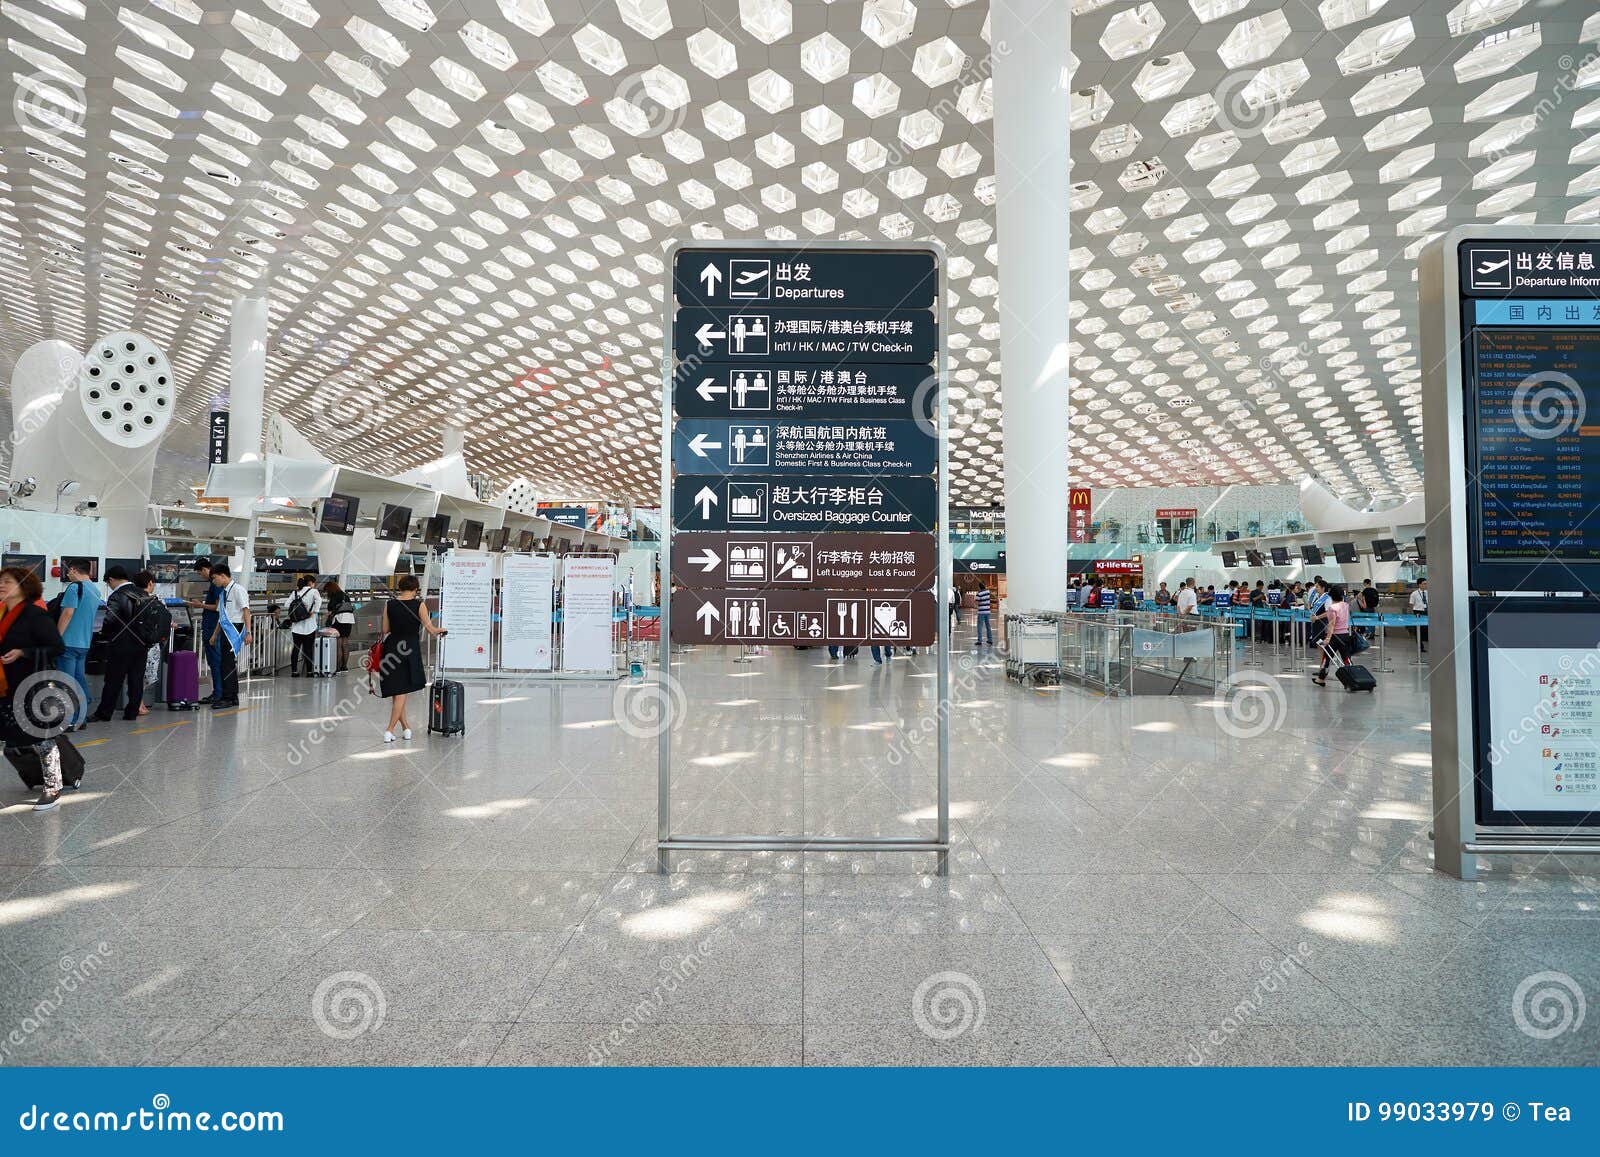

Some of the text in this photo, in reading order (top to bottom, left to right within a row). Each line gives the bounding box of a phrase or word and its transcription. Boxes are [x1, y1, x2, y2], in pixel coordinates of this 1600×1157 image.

[1516, 252, 1595, 270] 出发信息
[776, 262, 812, 282] 出发
[1516, 276, 1567, 288] Departure
[775, 286, 844, 300] Departures
[774, 320, 913, 334] 办理国际/港澳台乘机手续
[774, 342, 791, 352] Int'l
[798, 342, 814, 352] HK
[822, 342, 845, 352] MAC
[852, 342, 870, 352] TW
[872, 342, 913, 352] Check-in
[776, 385, 898, 396] 头等舱公务舱办理乘机手续
[776, 396, 788, 404] Int'l
[792, 396, 802, 404] HK
[806, 396, 823, 404] MAC
[827, 396, 838, 404] TW
[838, 396, 854, 404] First
[860, 396, 888, 404] Business
[888, 396, 906, 404] Class
[776, 426, 886, 440] 深航国航国内航班
[775, 440, 895, 452] 头等舱公务舱办理乘机手续
[776, 452, 808, 460] Shenzhen
[810, 452, 834, 460] Airlines
[842, 452, 852, 460] Air
[852, 452, 873, 460] China
[772, 486, 884, 506] 超大行李柜台
[773, 510, 912, 524] Oversized Baggage Counter
[266, 558, 284, 566] VJC
[816, 550, 916, 564] 行李寄存 失物招领
[832, 569, 862, 578] Luggage
